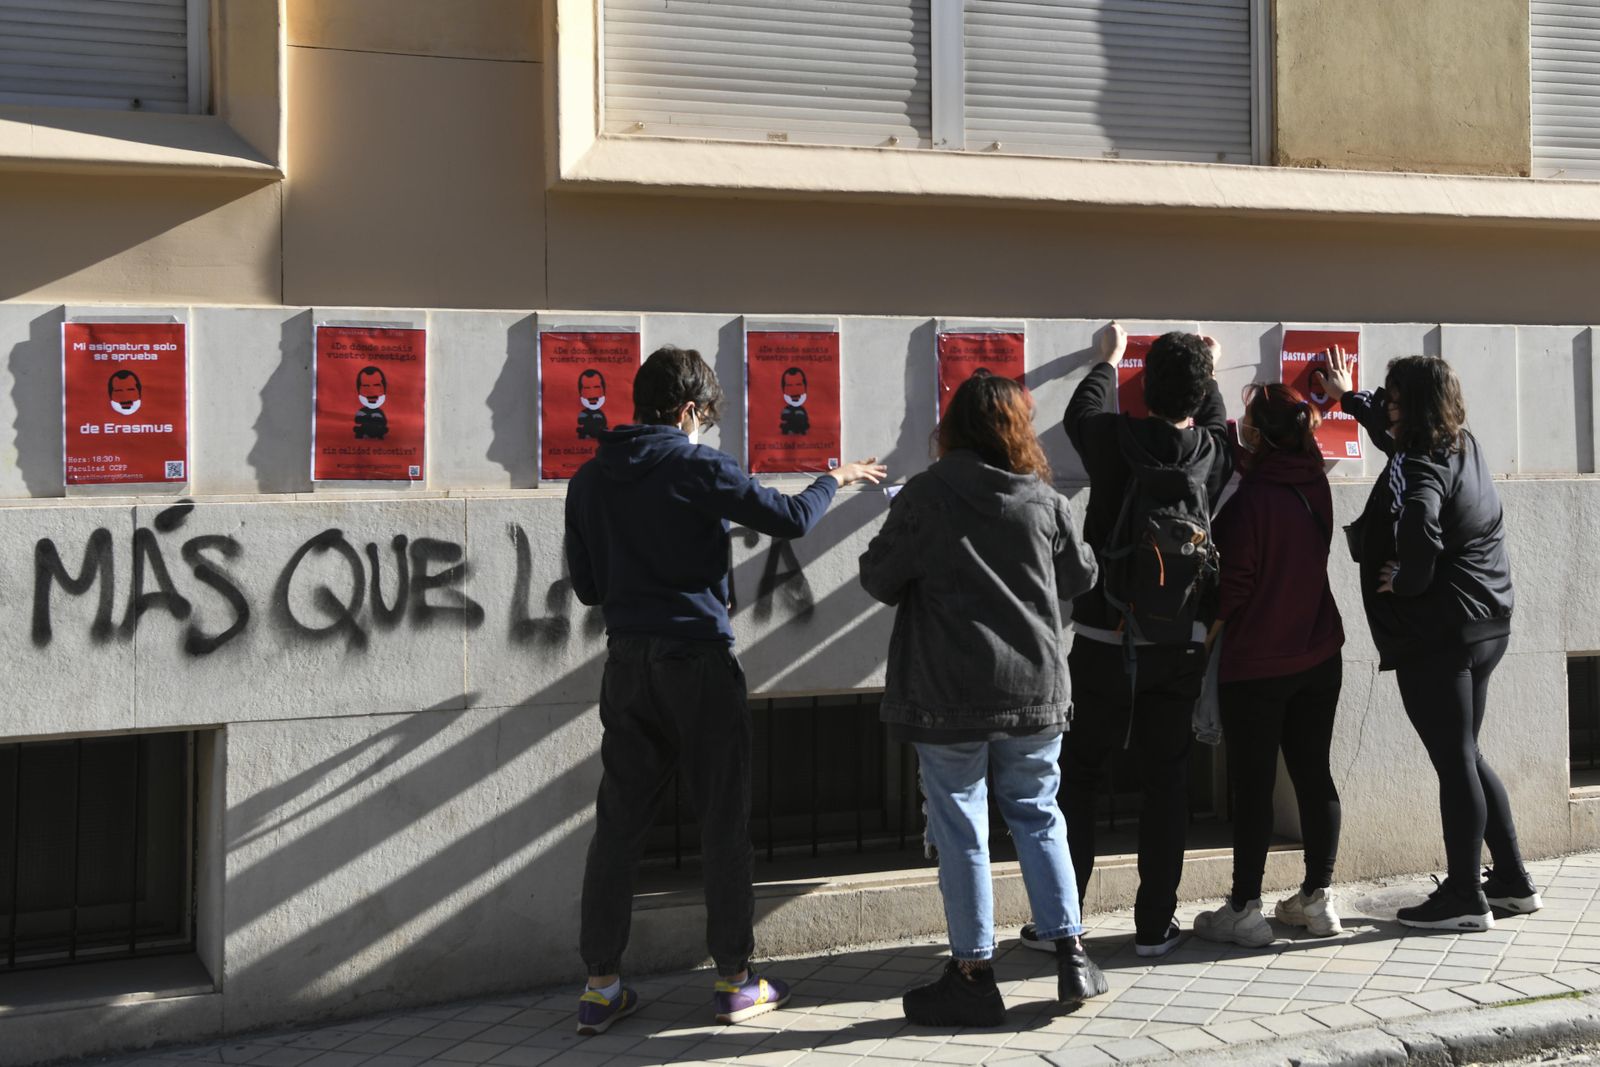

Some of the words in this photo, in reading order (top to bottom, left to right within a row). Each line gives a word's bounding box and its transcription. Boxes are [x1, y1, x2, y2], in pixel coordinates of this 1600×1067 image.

[73, 342, 86, 351] Mi
[88, 342, 150, 352] asignatura
[153, 342, 177, 351] solo
[94, 353, 108, 361] se
[111, 352, 158, 362] aprueba
[1282, 350, 1306, 361] BASTA
[1118, 358, 1143, 368] BASTA
[80, 422, 100, 434] de
[104, 422, 173, 434] Erasmus
[31, 499, 250, 657] MÁS
[275, 527, 486, 651] QUE
